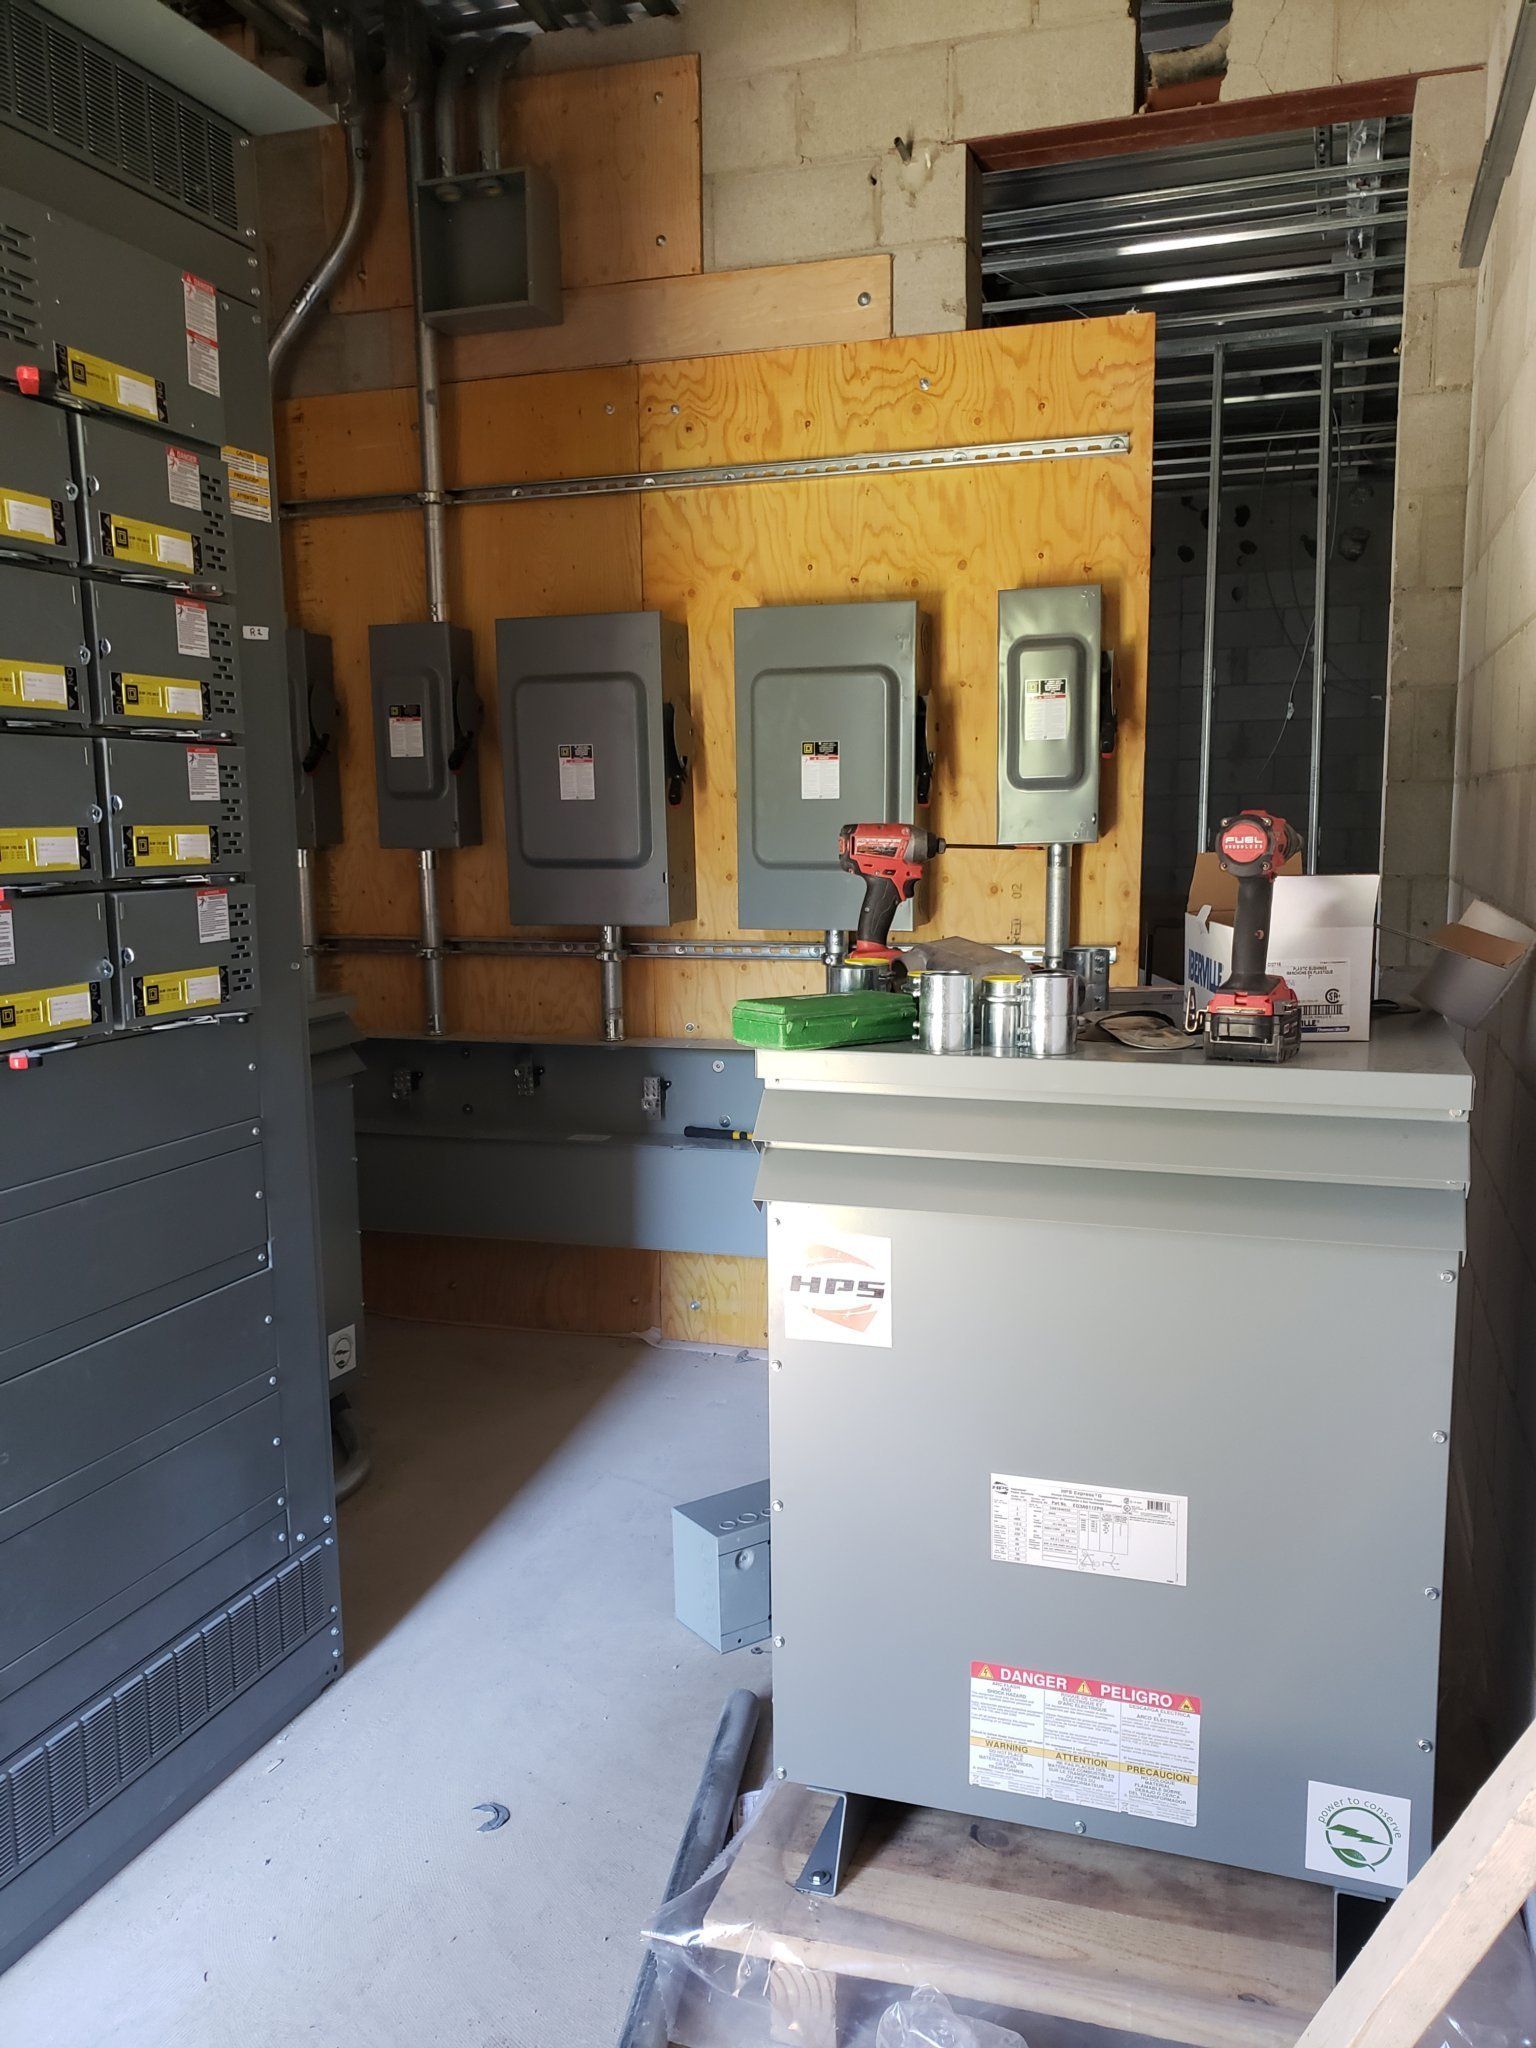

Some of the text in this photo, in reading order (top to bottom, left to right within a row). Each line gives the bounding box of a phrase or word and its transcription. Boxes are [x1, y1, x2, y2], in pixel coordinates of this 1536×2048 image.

[53, 501, 61, 520] ON
[105, 538, 112, 555] ON
[66, 667, 74, 686] ON
[115, 696, 122, 713] ON
[79, 828, 86, 845] ON
[1225, 836, 1263, 844] FUEL
[126, 849, 133, 865] ON
[91, 983, 98, 1000] ON
[136, 1000, 143, 1016] ON
[790, 1275, 885, 1299] HPS
[1000, 1667, 1173, 1708] DANGER PELIGRO
[985, 1740, 1028, 1754] WARNING
[1056, 1752, 1108, 1769] ATTENTION
[1126, 1764, 1190, 1783] PRECAUCION
[1318, 1797, 1402, 1839] power to conserve
